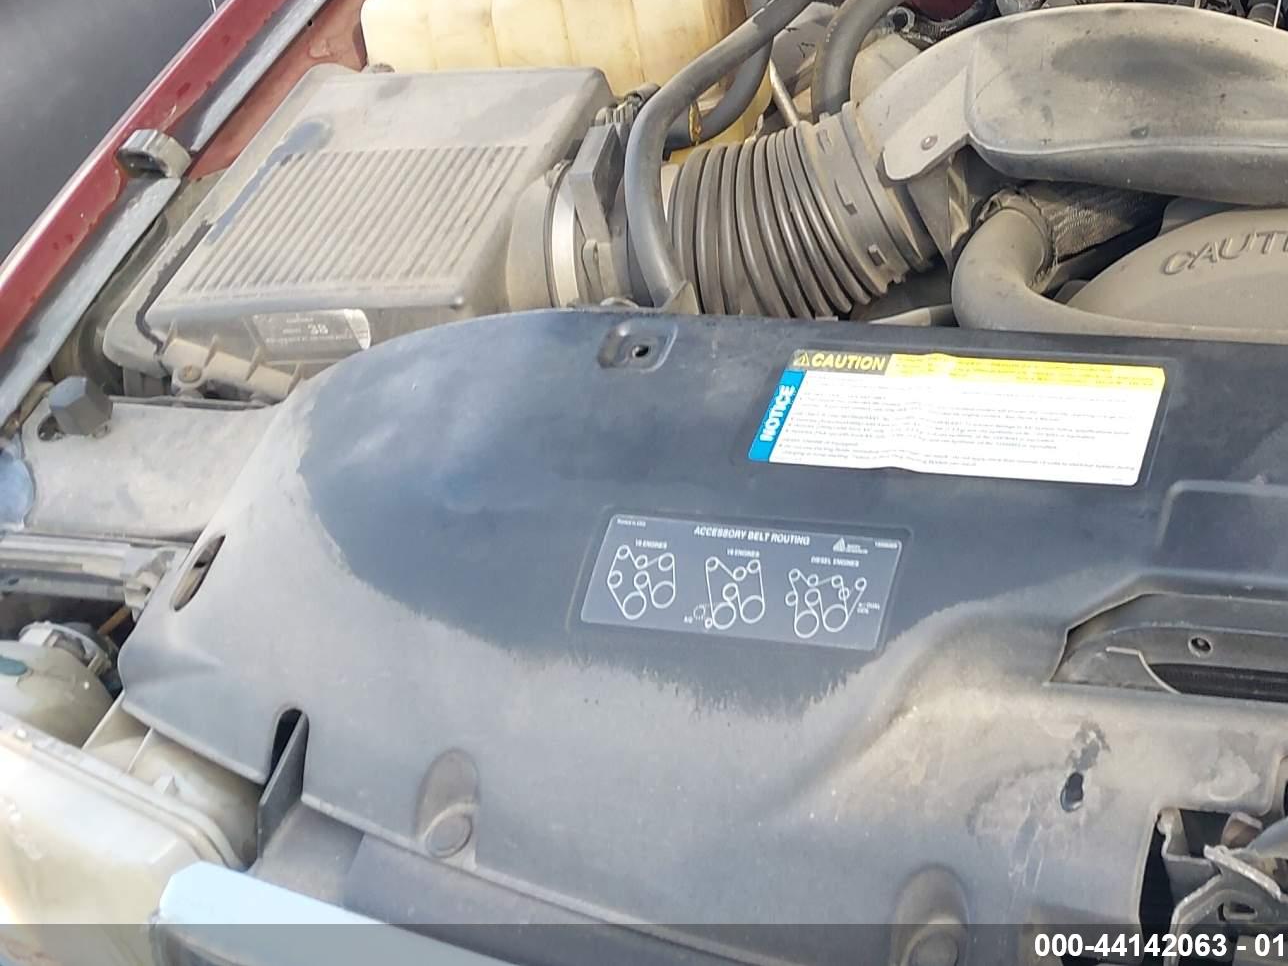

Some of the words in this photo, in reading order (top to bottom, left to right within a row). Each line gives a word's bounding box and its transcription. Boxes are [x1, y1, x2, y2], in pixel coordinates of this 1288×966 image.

[810, 352, 886, 371] CAUTION
[759, 384, 797, 442] NOTICE
[693, 525, 747, 541] ACCESSORY
[747, 530, 770, 542] BELT
[770, 532, 811, 546] ROUTING
